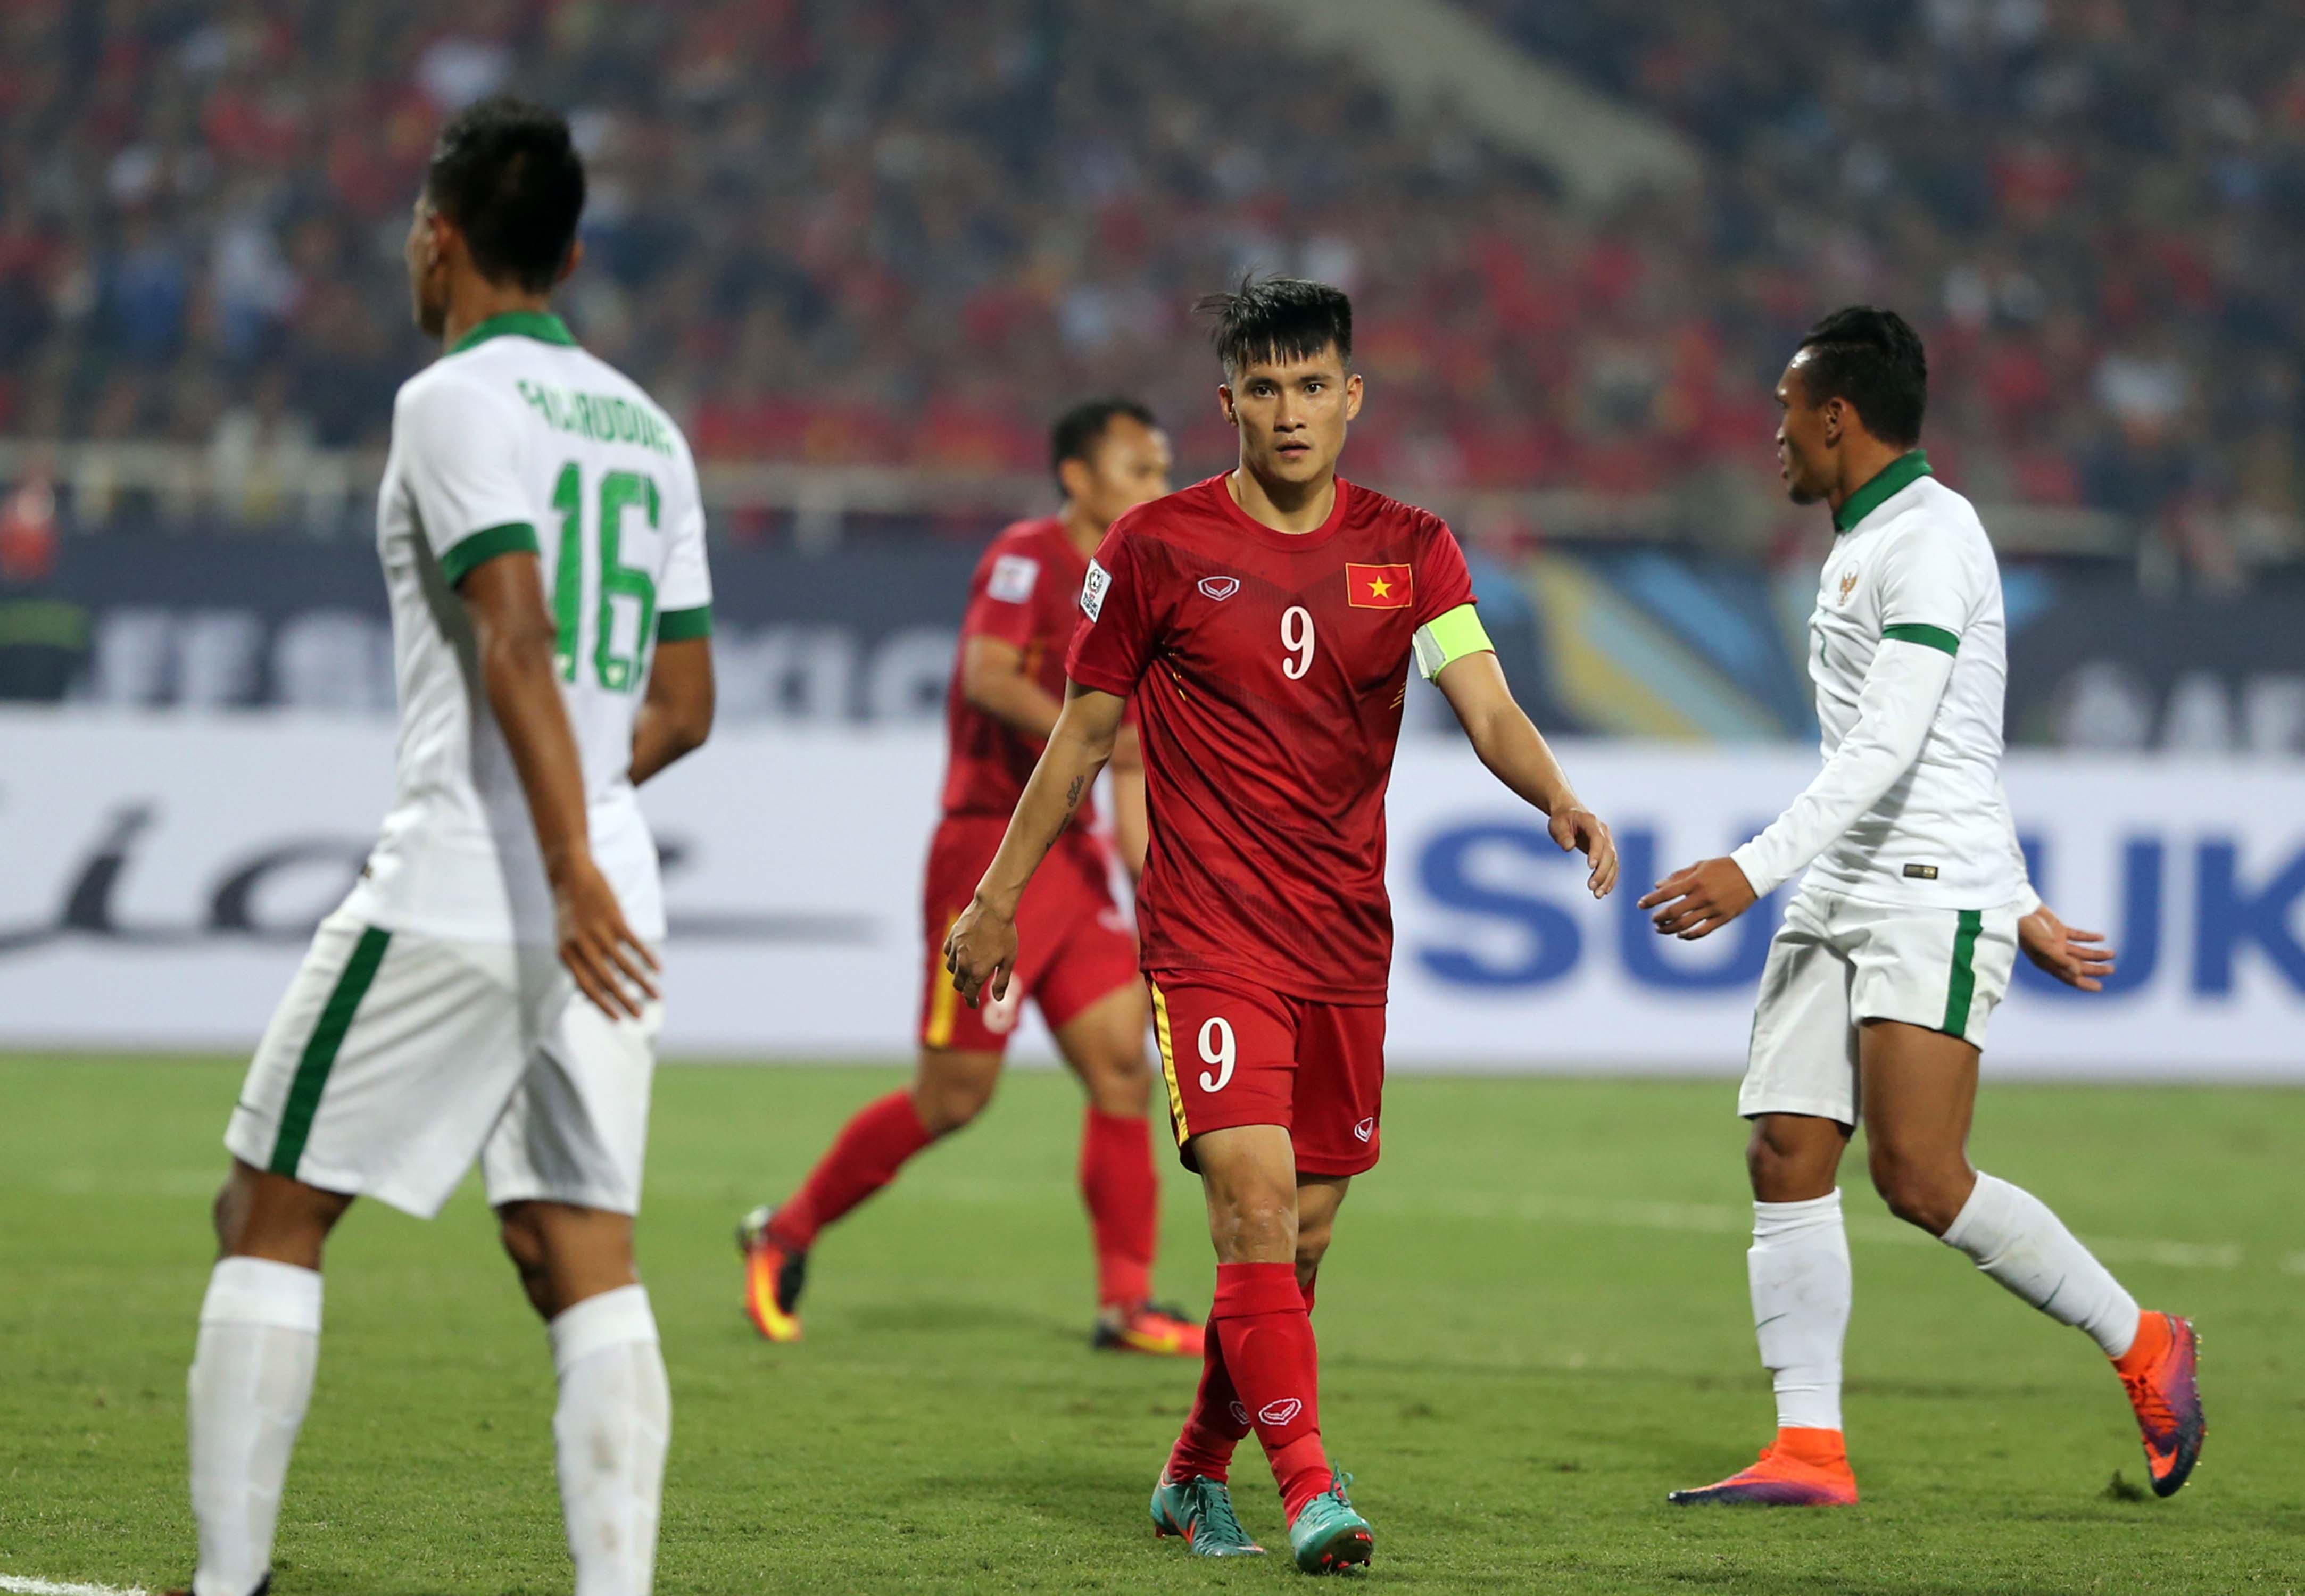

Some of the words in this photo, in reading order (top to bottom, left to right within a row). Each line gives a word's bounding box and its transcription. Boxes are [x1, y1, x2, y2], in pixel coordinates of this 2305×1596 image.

[550, 459, 660, 692] 16
[1280, 605, 1315, 680] 9
[1413, 819, 2305, 1000] SUUK
[1198, 1017, 1236, 1093] 9
